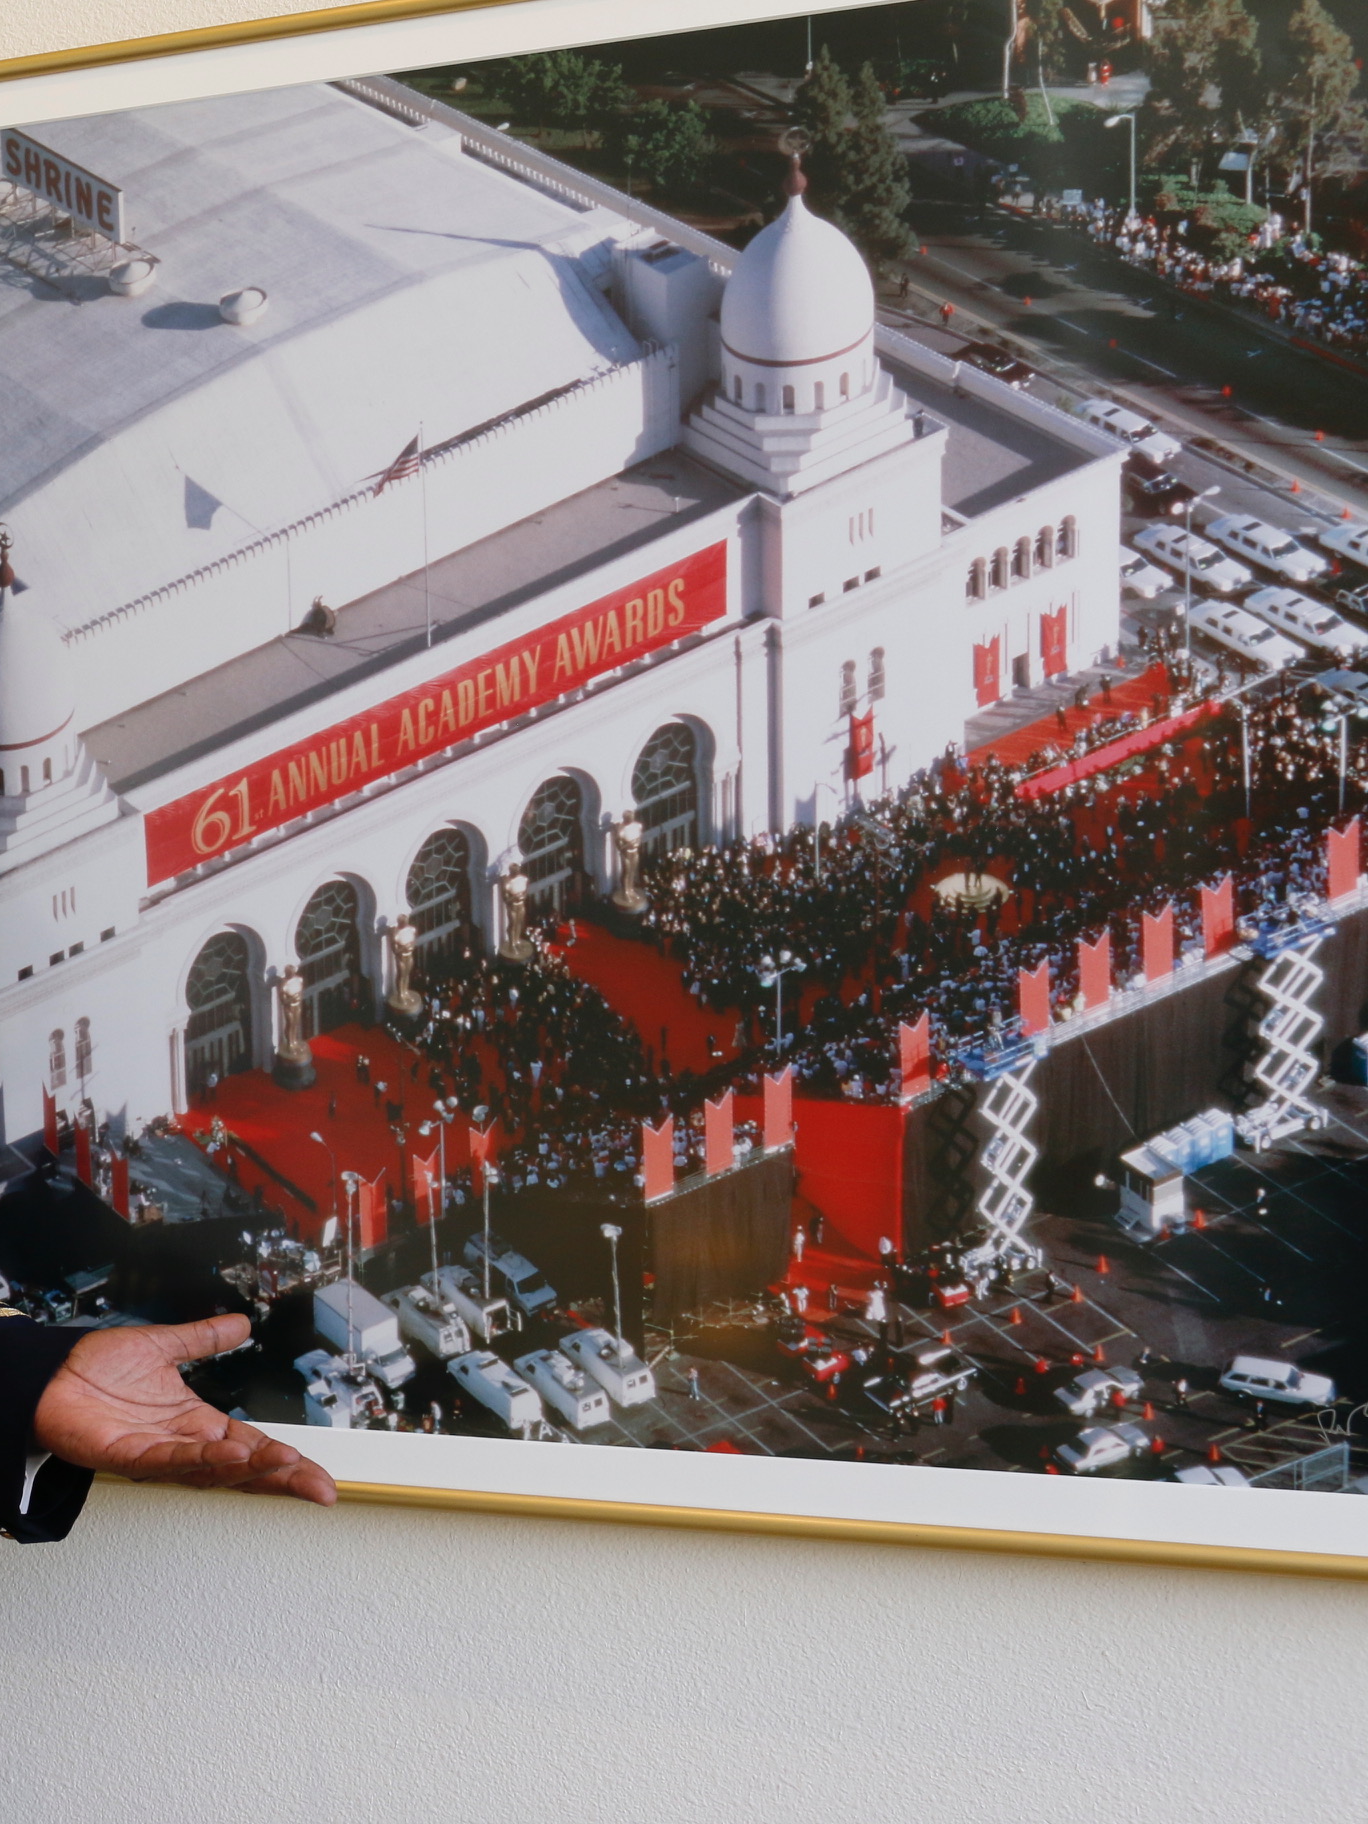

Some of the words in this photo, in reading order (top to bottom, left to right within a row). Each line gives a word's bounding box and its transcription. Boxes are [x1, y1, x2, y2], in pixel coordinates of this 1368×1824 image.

[5, 138, 115, 232] SHRINE
[267, 723, 385, 817] ANNUAL
[396, 645, 542, 757] ACADEMY
[553, 578, 686, 683] AWARDS
